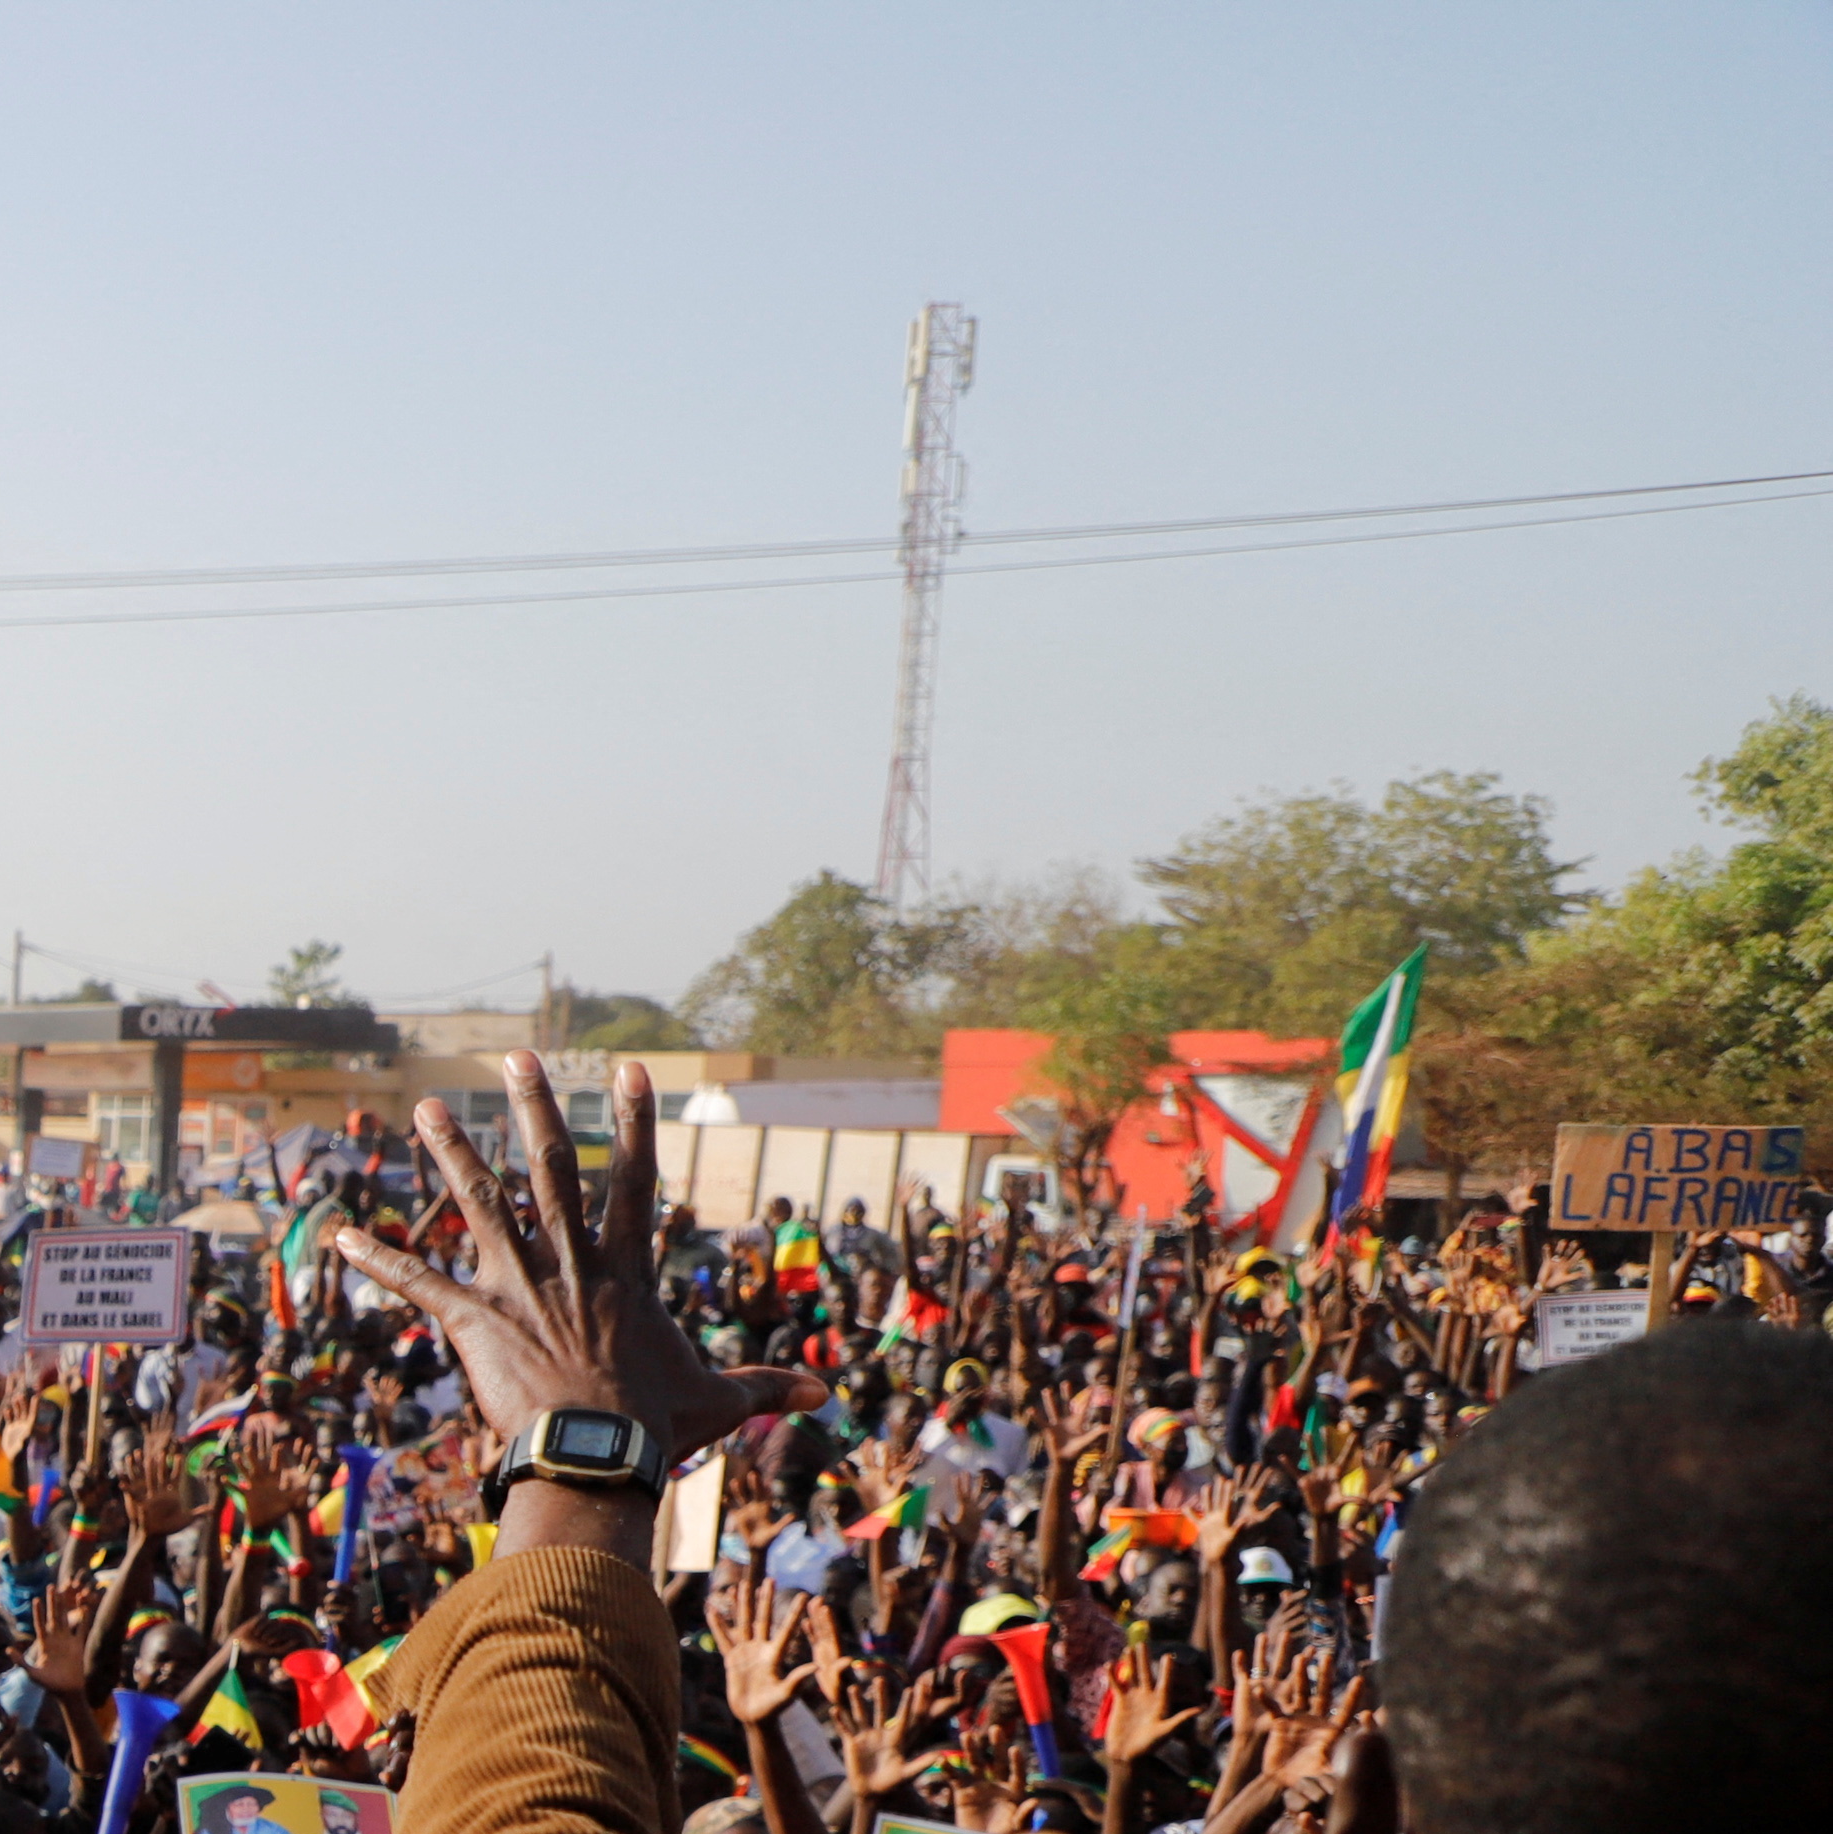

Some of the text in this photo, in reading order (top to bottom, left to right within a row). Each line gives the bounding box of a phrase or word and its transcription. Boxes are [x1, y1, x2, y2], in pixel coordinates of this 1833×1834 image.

[139, 1006, 215, 1037] ORYX
[44, 1247, 79, 1262] STOP
[82, 1246, 100, 1260] AU
[59, 1266, 153, 1283] DE LA FRANCE
[76, 1290, 134, 1305] AU MALI
[41, 1312, 163, 1328] ET DANS LE SAHEL
